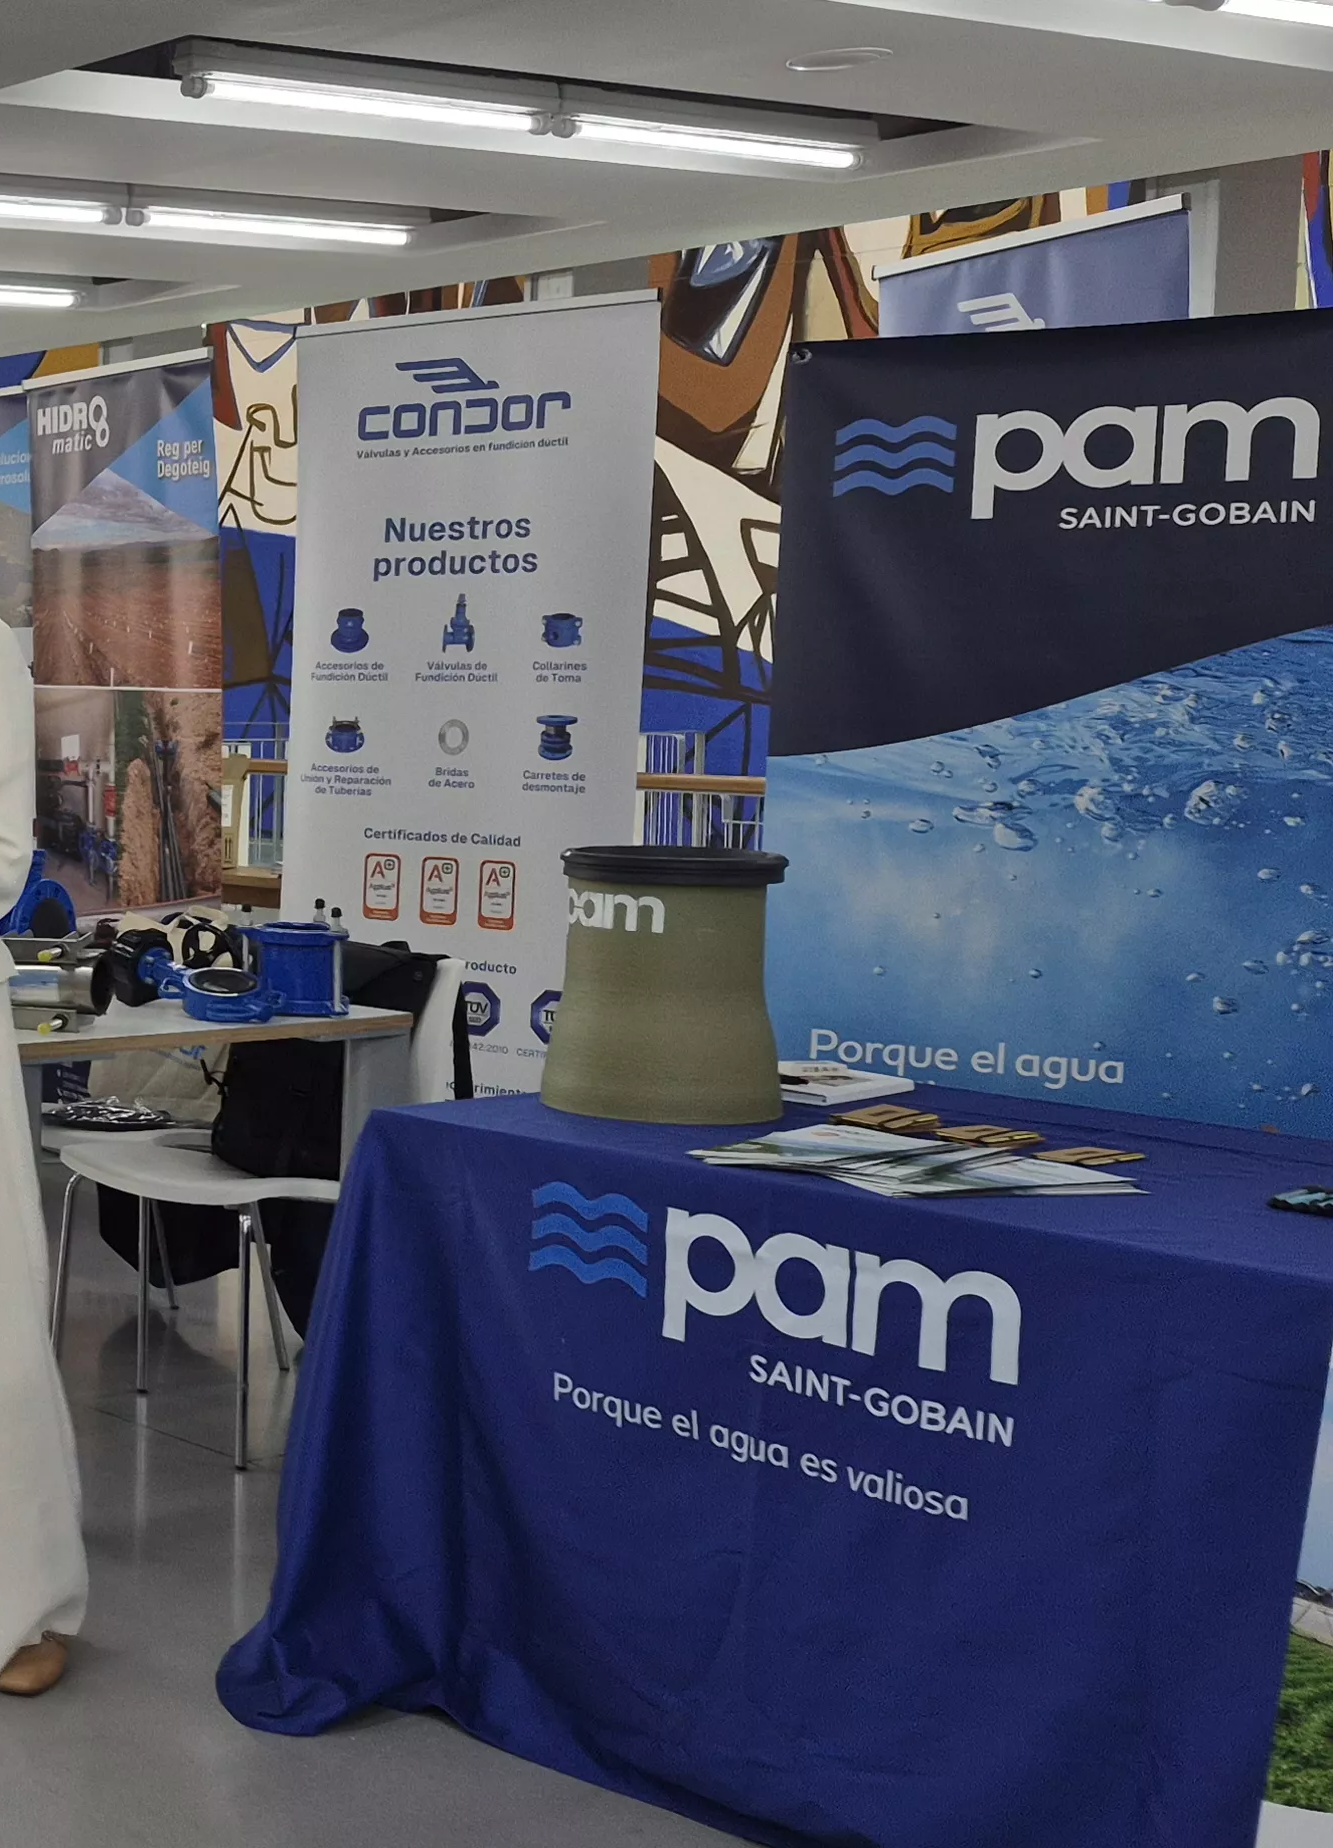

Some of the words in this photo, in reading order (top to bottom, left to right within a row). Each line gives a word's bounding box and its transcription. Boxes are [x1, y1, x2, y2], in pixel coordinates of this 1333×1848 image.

[52, 431, 93, 454] matic
[157, 440, 180, 460] Reg
[183, 439, 203, 459] per
[404, 448, 410, 458] y
[412, 443, 471, 456] Accesorios
[472, 443, 486, 453] en
[971, 397, 1320, 519] pam
[157, 456, 210, 481] Degoteig
[1059, 500, 1316, 530] SAINT-GOBAIN
[384, 516, 531, 543] Nuestros
[373, 550, 538, 582] productos
[315, 661, 369, 671] Accesorios
[371, 661, 384, 671] de
[427, 660, 472, 671] Válvulas
[474, 660, 487, 671] de
[532, 660, 587, 671] Collarines
[311, 672, 356, 682] Fundición
[358, 672, 389, 682] Dúctil
[415, 672, 465, 682] Fundición
[535, 673, 549, 683] de
[552, 674, 582, 683] Toma
[311, 763, 364, 774] Accesorios
[366, 765, 380, 775] de
[435, 767, 469, 777] Bridas
[523, 770, 569, 781] Carretes
[571, 772, 586, 782] de
[334, 775, 392, 786] Reparación
[428, 778, 442, 788] de
[444, 779, 475, 789] Acero
[315, 786, 327, 795] de
[522, 782, 586, 795] desmontaje
[364, 827, 447, 843] Certificados
[451, 832, 468, 844] de
[471, 833, 521, 847] Calidad
[465, 960, 517, 975] roducto
[809, 1028, 958, 1076] Porque
[971, 1042, 1005, 1074] el
[1015, 1054, 1125, 1089] agua
[662, 1207, 1021, 1385] pam
[749, 1355, 1015, 1447] SAINT-GOBAIN
[553, 1371, 662, 1427] Porque
[672, 1410, 699, 1440] el
[710, 1424, 789, 1469] agua
[800, 1453, 837, 1484] es
[847, 1464, 968, 1520] valiosa
